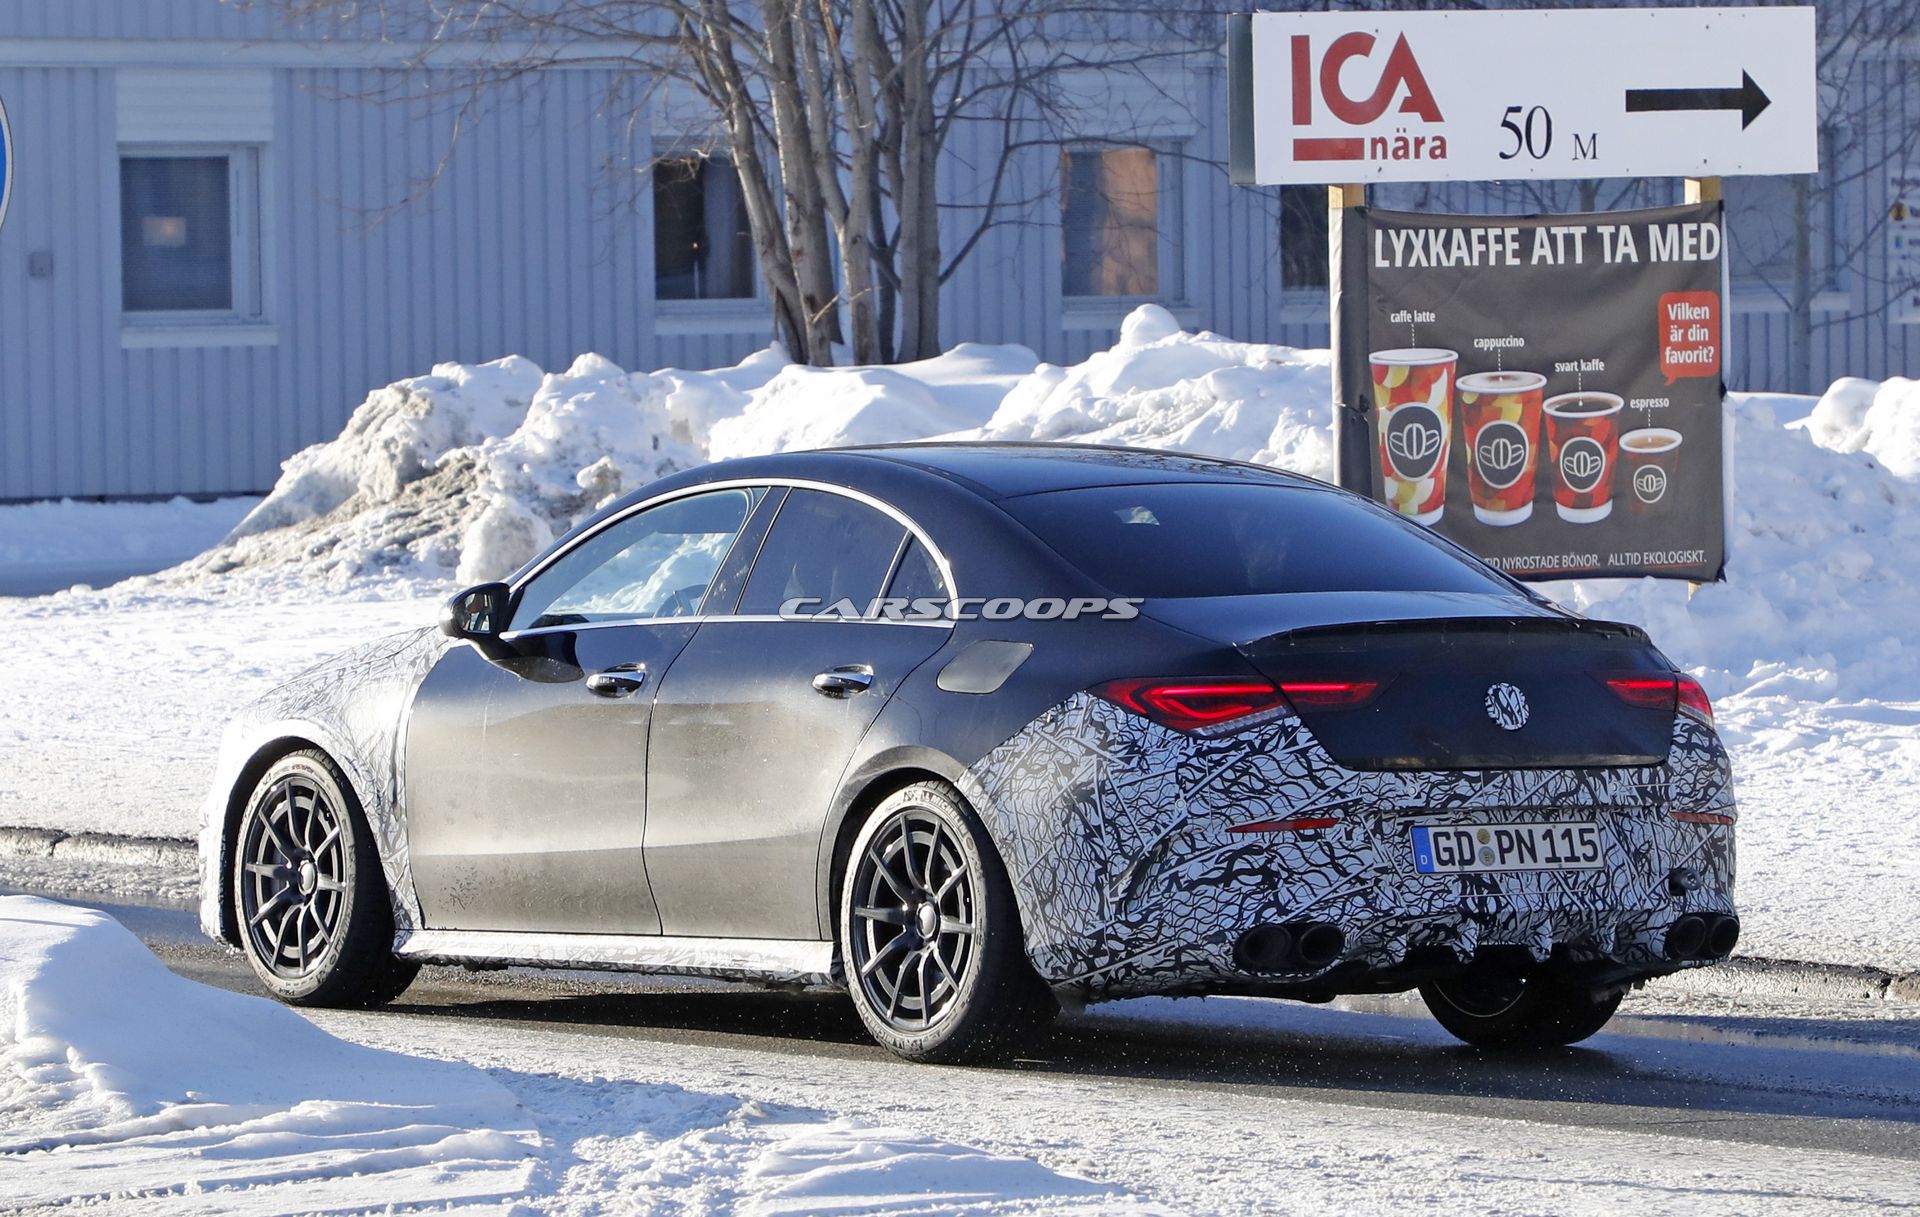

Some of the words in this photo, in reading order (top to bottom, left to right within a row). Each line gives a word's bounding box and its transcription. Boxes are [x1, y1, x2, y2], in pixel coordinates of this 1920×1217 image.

[1291, 31, 1445, 125] ICA
[1499, 105, 1552, 160] 50
[1572, 133, 1598, 161] M
[1370, 127, 1447, 160] nära
[1374, 226, 1521, 268] LYXKAFFE
[1531, 225, 1587, 266] ATT
[1597, 224, 1638, 264] TA
[1649, 221, 1720, 262] MED
[1390, 310, 1413, 323] caffe
[1414, 310, 1436, 323] latte
[1667, 302, 1710, 320] Vilken
[1670, 324, 1684, 342] är
[1688, 323, 1709, 342] din
[1473, 335, 1525, 351] cappuccino
[1665, 345, 1715, 364] favorit?
[1555, 361, 1579, 373] svart
[1580, 359, 1605, 372] kaffe
[1630, 397, 1670, 411] espresso
[1502, 555, 1560, 570] NYROSTADE
[1562, 551, 1600, 567] BÖNOR.
[1608, 551, 1642, 566] ALLTID
[1644, 550, 1707, 565] EKOLOGISKT.
[930, 792, 969, 837] MICHELIN
[1432, 831, 1476, 866] GD
[1494, 829, 1538, 864] PN
[1542, 827, 1599, 863] 115
[1420, 854, 1428, 865] D
